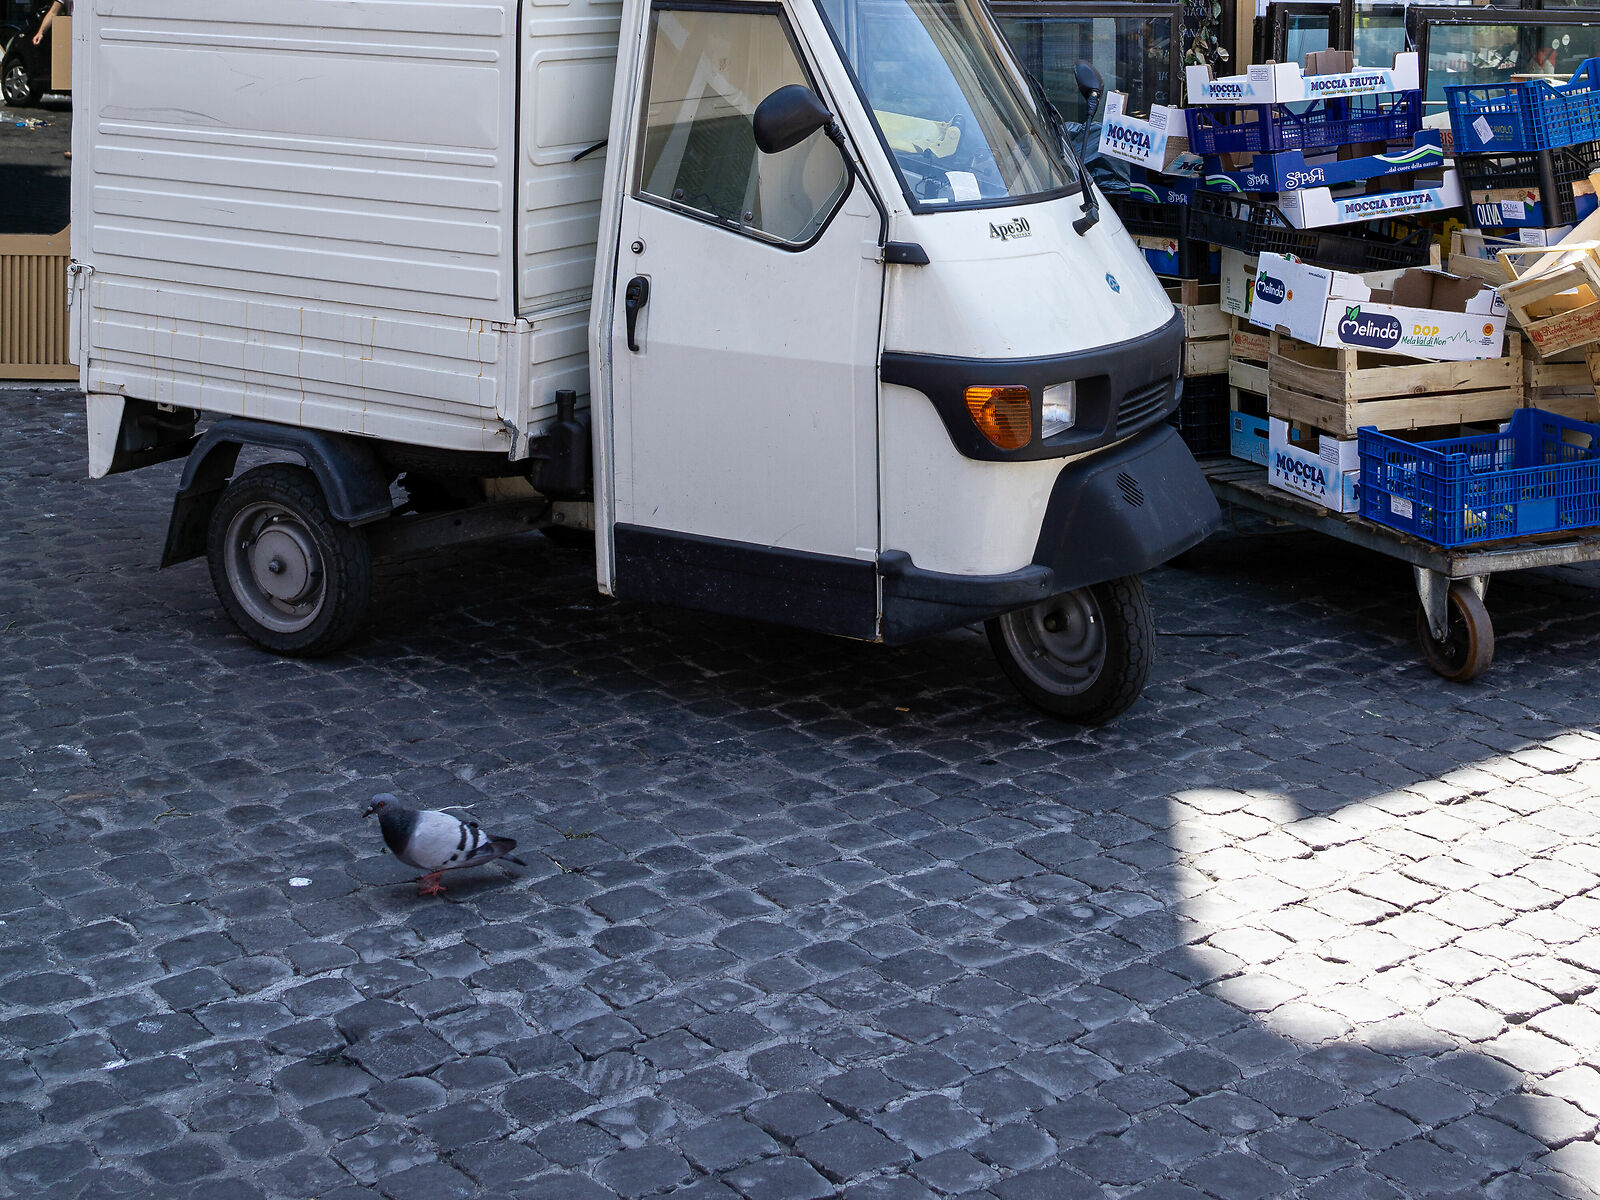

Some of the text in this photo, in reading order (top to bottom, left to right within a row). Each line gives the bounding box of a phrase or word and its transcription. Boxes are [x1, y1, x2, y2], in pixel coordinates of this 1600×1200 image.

[1209, 84, 1242, 92] MOCCIA
[1310, 76, 1386, 91] MOCCIA FRUTTA
[1107, 124, 1150, 149] MOCCIA
[1106, 138, 1150, 158] FRUTTA
[1344, 193, 1432, 214] MOCCIA FRUTTA
[1476, 204, 1503, 226] OLIVA
[1257, 280, 1284, 298] Melinda
[1340, 320, 1398, 340] Melinda
[1401, 336, 1416, 344] Mela
[1417, 336, 1426, 344] Val
[1434, 338, 1446, 346] Non
[1276, 452, 1326, 486] MOCCIA
[1276, 468, 1326, 496] FRUTTA
